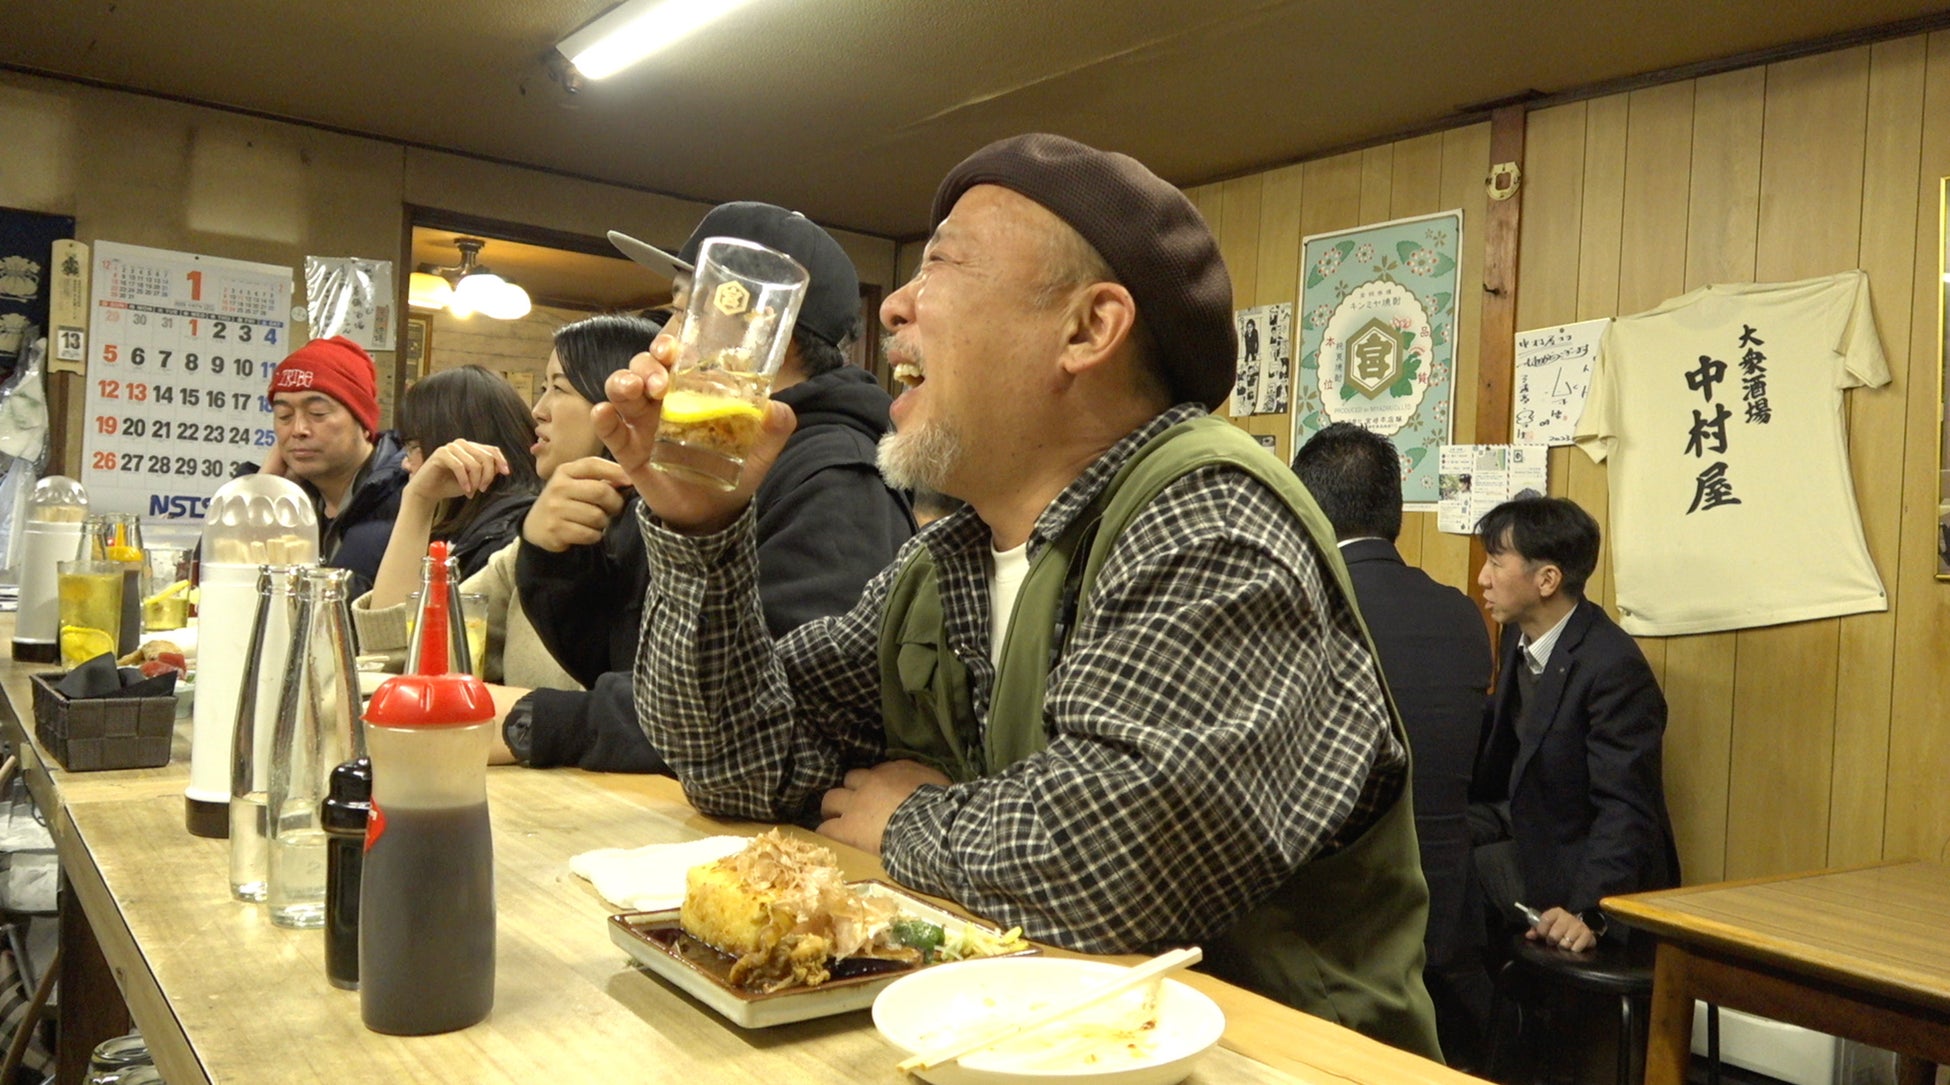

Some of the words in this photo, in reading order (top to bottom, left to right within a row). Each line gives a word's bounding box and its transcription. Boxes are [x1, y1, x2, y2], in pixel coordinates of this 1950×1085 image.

[186, 270, 202, 301] 1
[61, 332, 80, 349] 13
[105, 311, 120, 322] 29
[133, 313, 146, 325] 30
[161, 317, 173, 328] 31
[189, 319, 198, 336] 1
[212, 322, 227, 340] 2
[238, 325, 251, 342] 3
[264, 328, 277, 345] 4
[103, 344, 118, 363] 5
[131, 347, 145, 365] 6
[158, 350, 172, 368] 7
[184, 353, 198, 371] 8
[211, 356, 224, 373] 9
[233, 358, 253, 377] 10
[1738, 324, 1772, 425] 大衆酒場
[98, 379, 119, 399] 12
[126, 382, 147, 401] 13
[153, 385, 173, 404] 14
[179, 388, 199, 406] 15
[206, 390, 225, 409] 16
[231, 393, 251, 411] 17
[95, 416, 117, 434] 19
[122, 418, 146, 437] 20
[151, 420, 171, 439] 21
[176, 422, 199, 441] 22
[203, 425, 224, 443] 23
[228, 427, 250, 445] 24
[254, 429, 276, 446] 25
[1684, 355, 1742, 515] 中村屋
[92, 451, 117, 470] 26
[120, 453, 144, 472] 27
[148, 455, 171, 473] 28
[174, 457, 197, 475] 29
[201, 459, 223, 477] 30
